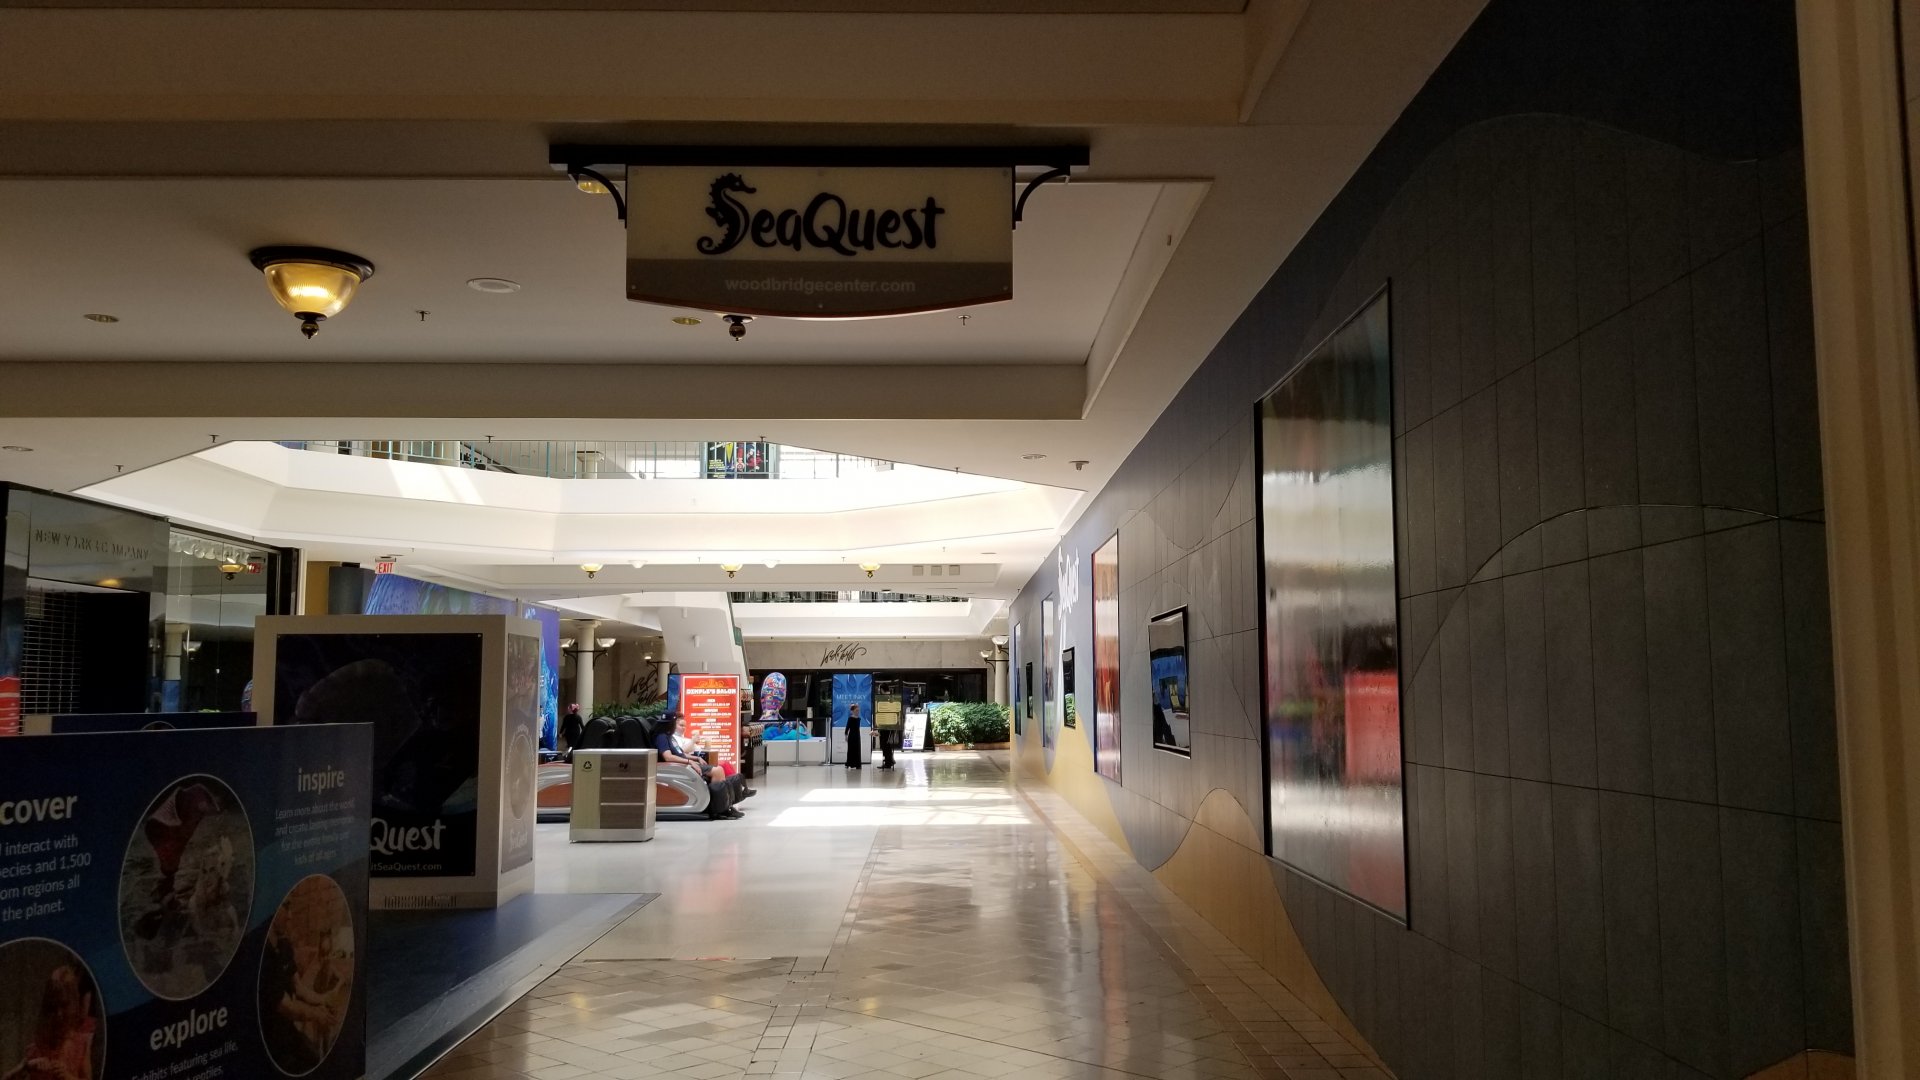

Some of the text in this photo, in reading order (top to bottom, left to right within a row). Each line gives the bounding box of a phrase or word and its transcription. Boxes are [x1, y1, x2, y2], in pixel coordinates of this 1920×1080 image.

[697, 172, 945, 256] SeaQuest
[724, 276, 917, 295] woodbridgecenter.com
[378, 562, 394, 574] EXIT
[298, 765, 345, 795] inspire
[0, 795, 78, 826] cover
[5, 838, 51, 857] interact
[53, 832, 79, 850] with
[34, 856, 57, 874] and
[22, 877, 65, 897] regions
[67, 873, 81, 890] all
[2, 899, 65, 922] the planet.
[150, 1006, 229, 1052] explore
[170, 1052, 209, 1075] featuring
[209, 1047, 223, 1059] sea
